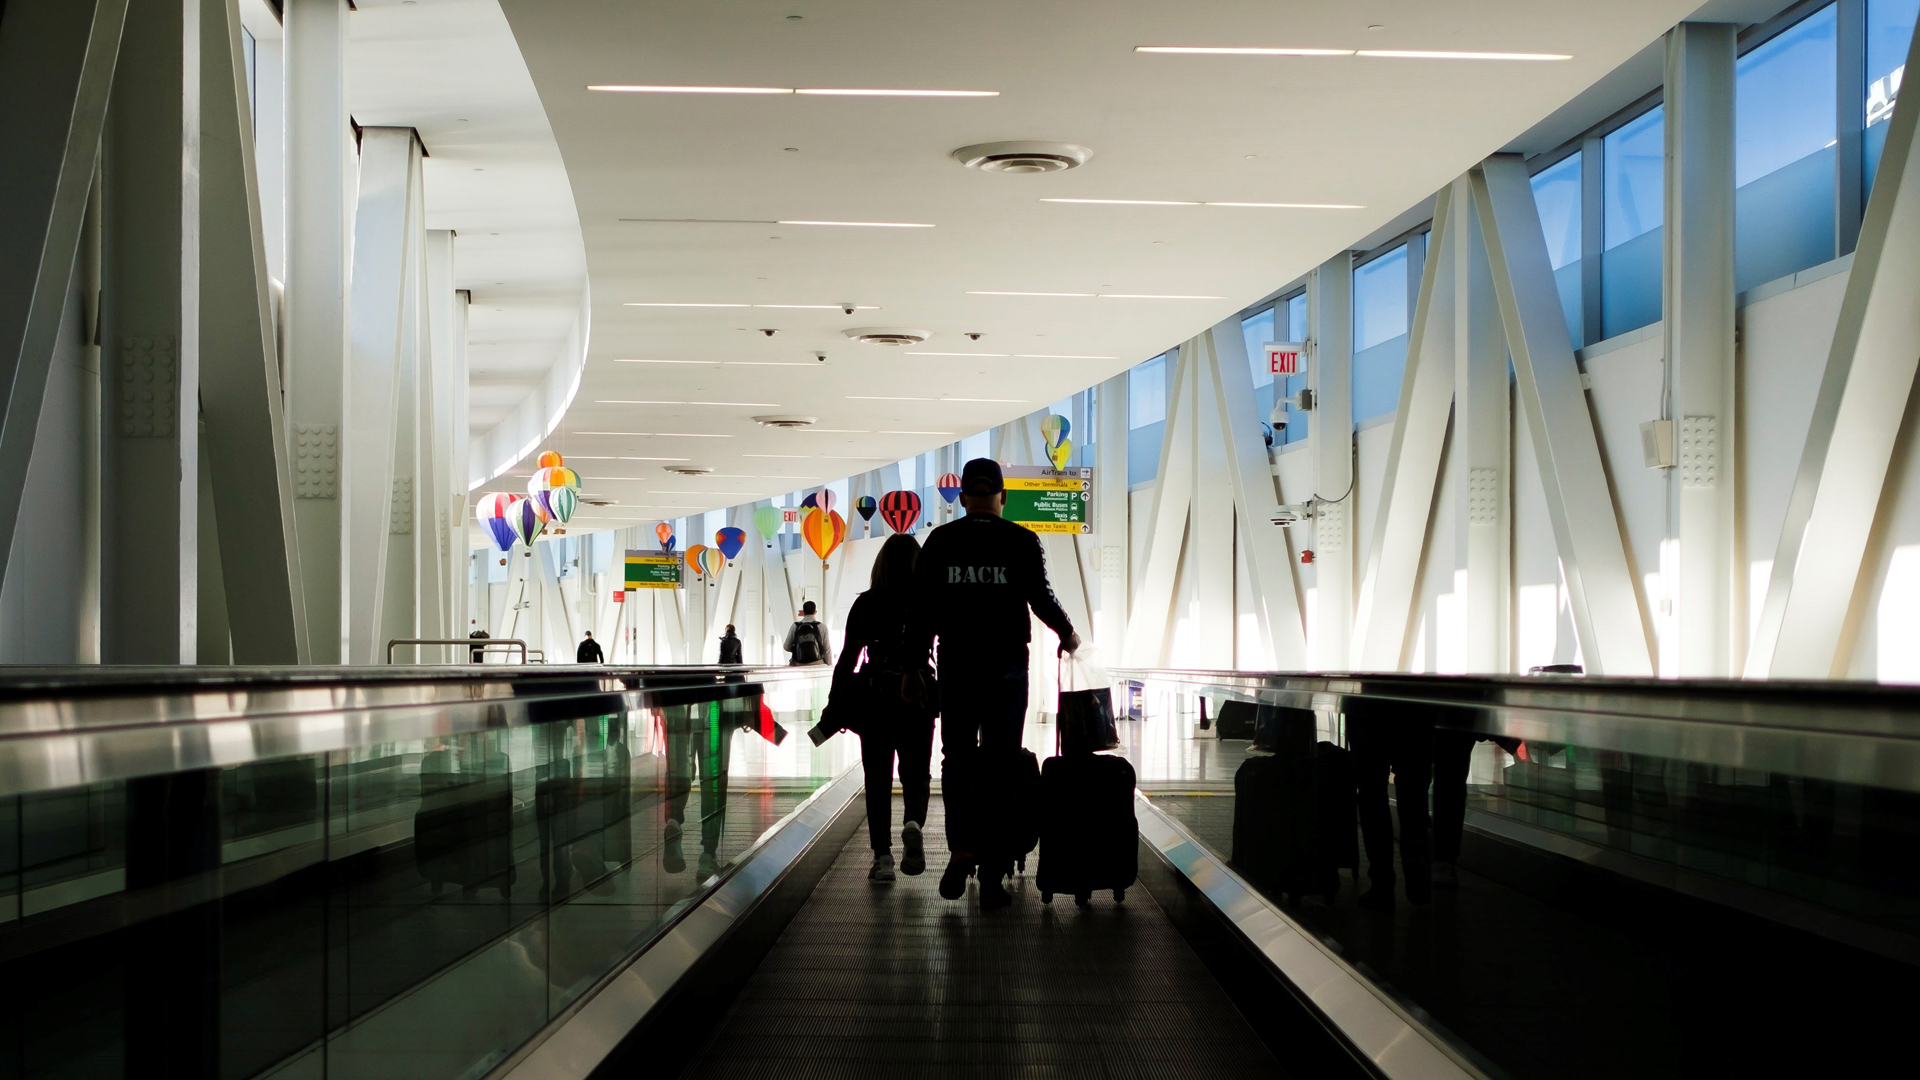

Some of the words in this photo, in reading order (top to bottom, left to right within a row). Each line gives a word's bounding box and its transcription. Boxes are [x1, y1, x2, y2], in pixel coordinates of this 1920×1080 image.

[1271, 352, 1297, 373] EXIT
[784, 511, 797, 521] EXIT
[947, 566, 1008, 584] BACK
